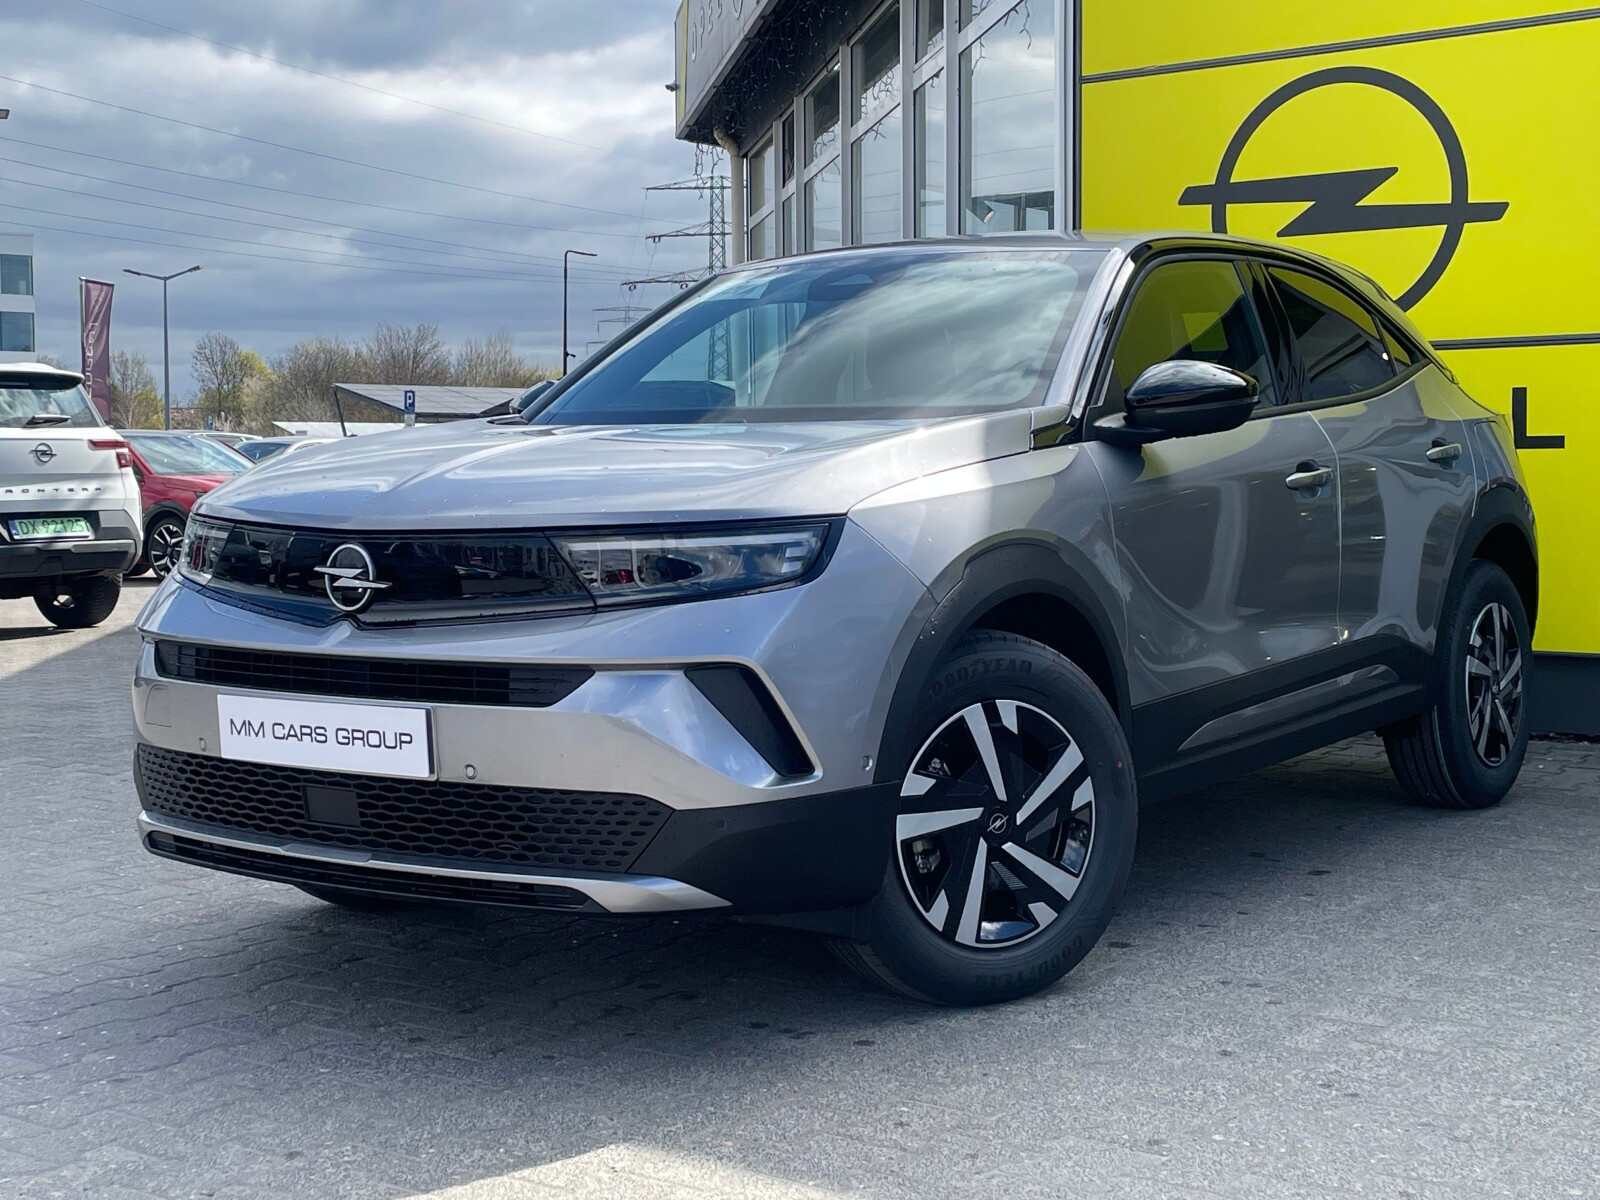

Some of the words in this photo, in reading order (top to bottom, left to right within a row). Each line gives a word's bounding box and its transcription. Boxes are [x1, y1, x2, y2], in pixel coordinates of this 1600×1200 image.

[18, 520, 39, 535] DX
[229, 718, 265, 738] MM
[271, 722, 328, 744] CARS
[335, 727, 413, 750] GROUP
